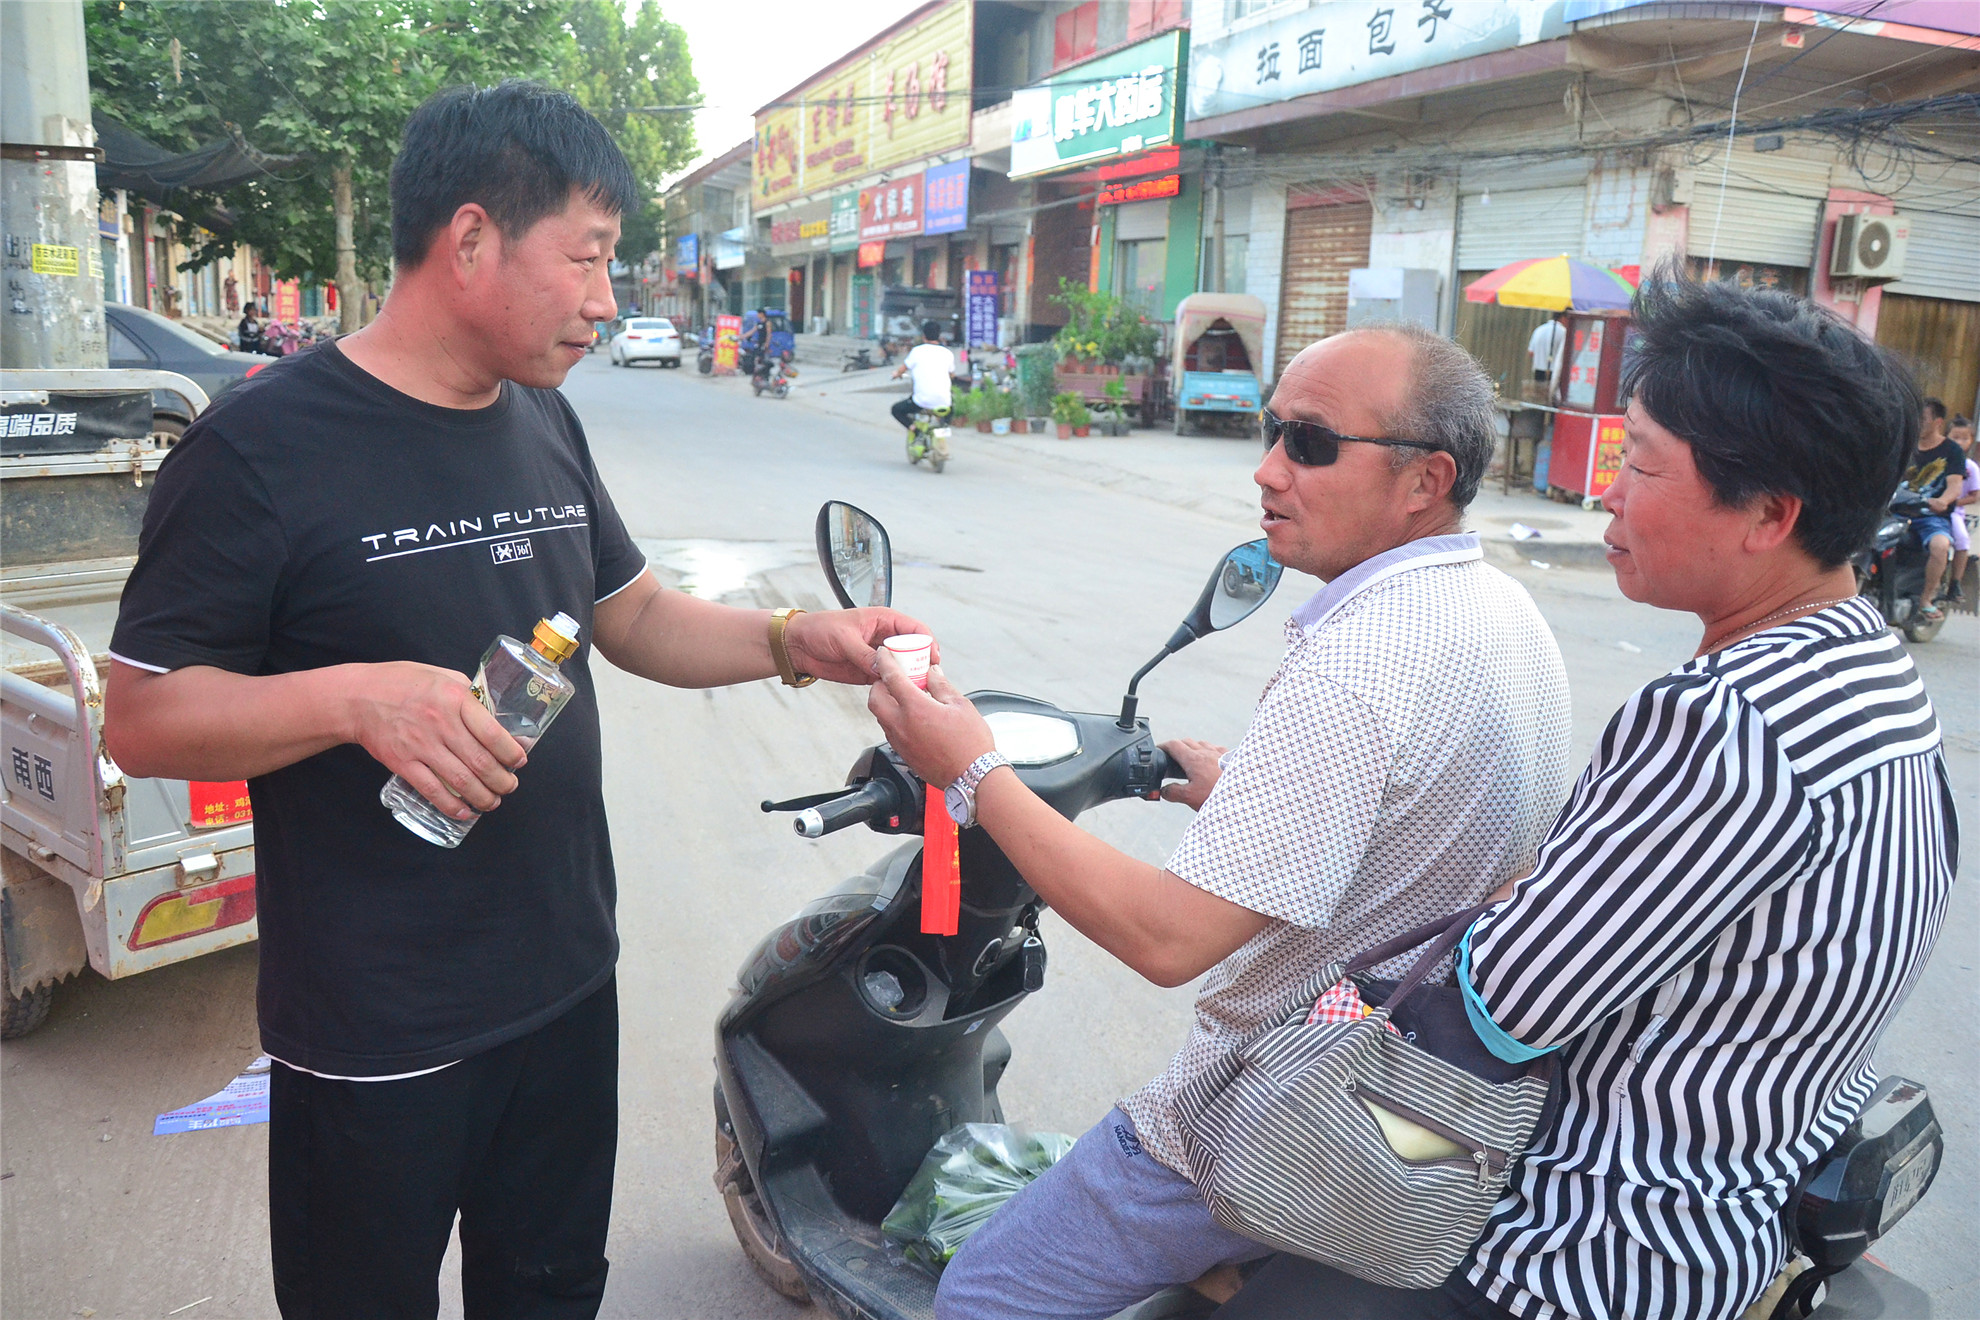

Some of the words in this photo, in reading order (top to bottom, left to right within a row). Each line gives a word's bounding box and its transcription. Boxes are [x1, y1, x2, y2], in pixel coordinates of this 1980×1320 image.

[1257, 28, 1327, 85] 拉面
[1367, 0, 1453, 56] 包子
[361, 516, 483, 550] TRAIN
[493, 505, 587, 528] FUTURE
